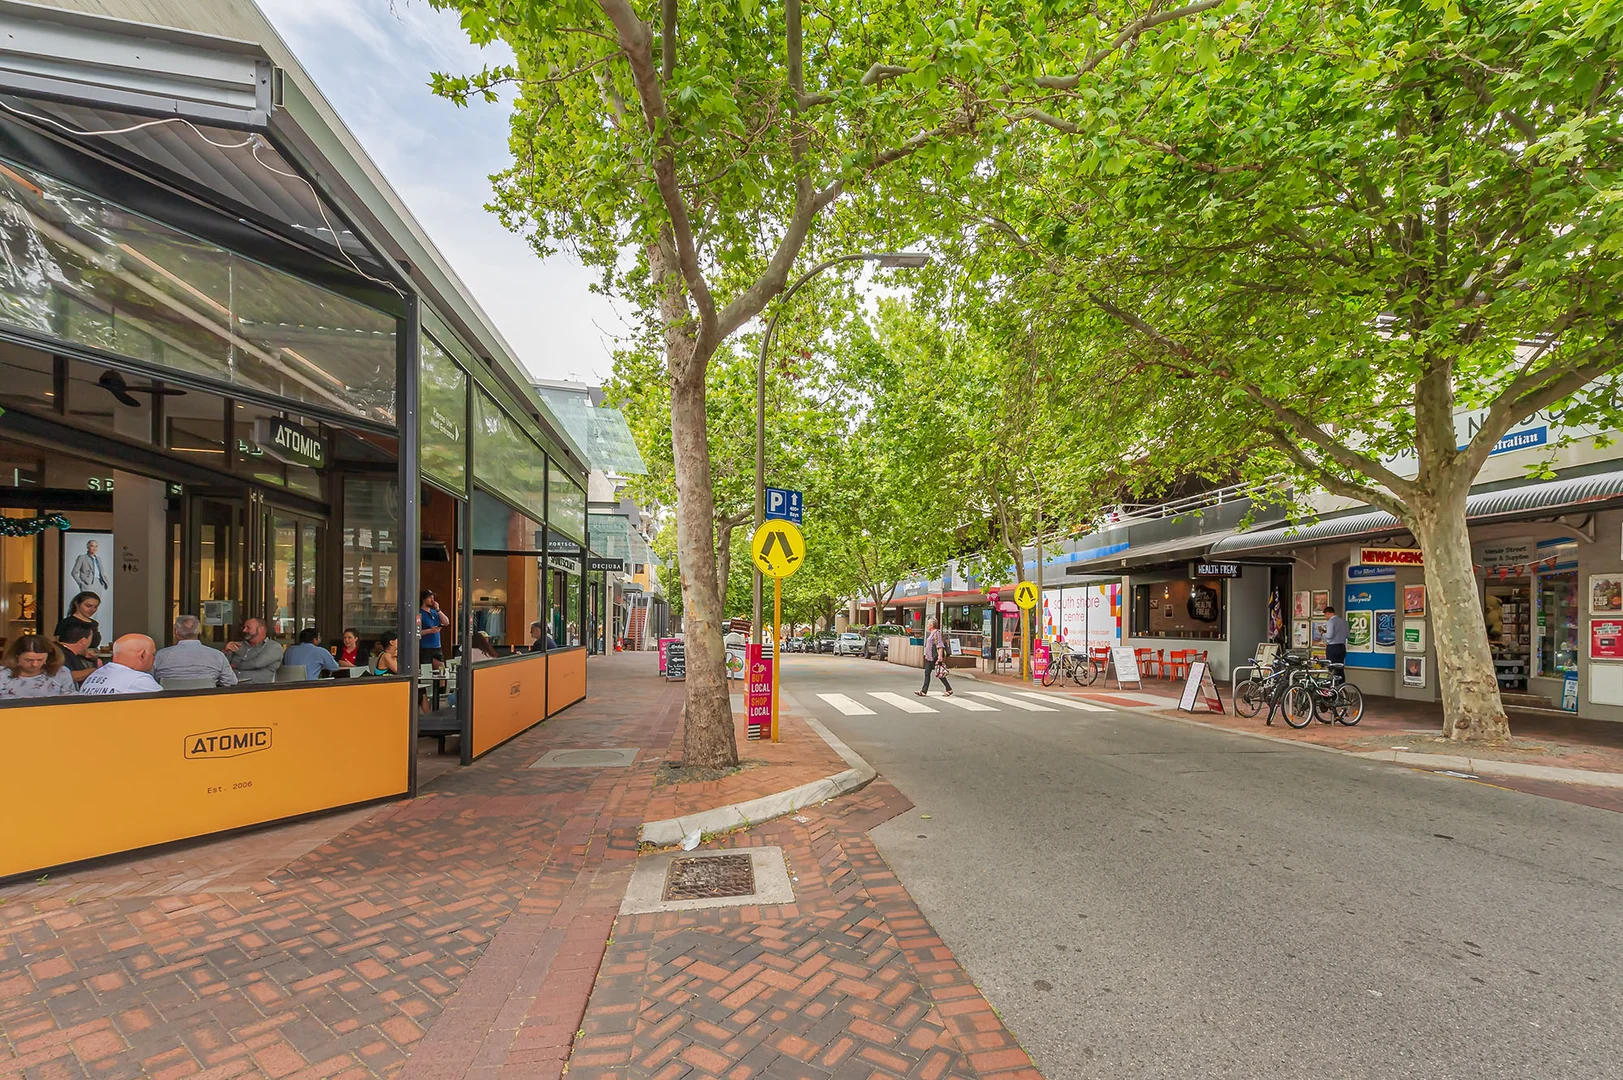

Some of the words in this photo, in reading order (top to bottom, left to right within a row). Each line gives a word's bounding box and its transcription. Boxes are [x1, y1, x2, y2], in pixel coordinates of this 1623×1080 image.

[275, 424, 321, 460] ATOMIC
[1492, 433, 1538, 451] stralian
[770, 492, 783, 512] P
[1362, 550, 1424, 564] NEWSAGENC
[1198, 564, 1219, 574] HEALTH
[1220, 564, 1238, 574] FREAK
[1054, 596, 1075, 609] south
[1076, 595, 1100, 608] shore
[1064, 611, 1085, 622] centre
[752, 674, 764, 682] BUY
[752, 683, 770, 692] LOCAL
[750, 697, 768, 706] SHOP
[750, 706, 770, 716] LOCAL
[191, 732, 266, 754] ATOMIC
[232, 780, 252, 790] 2006
